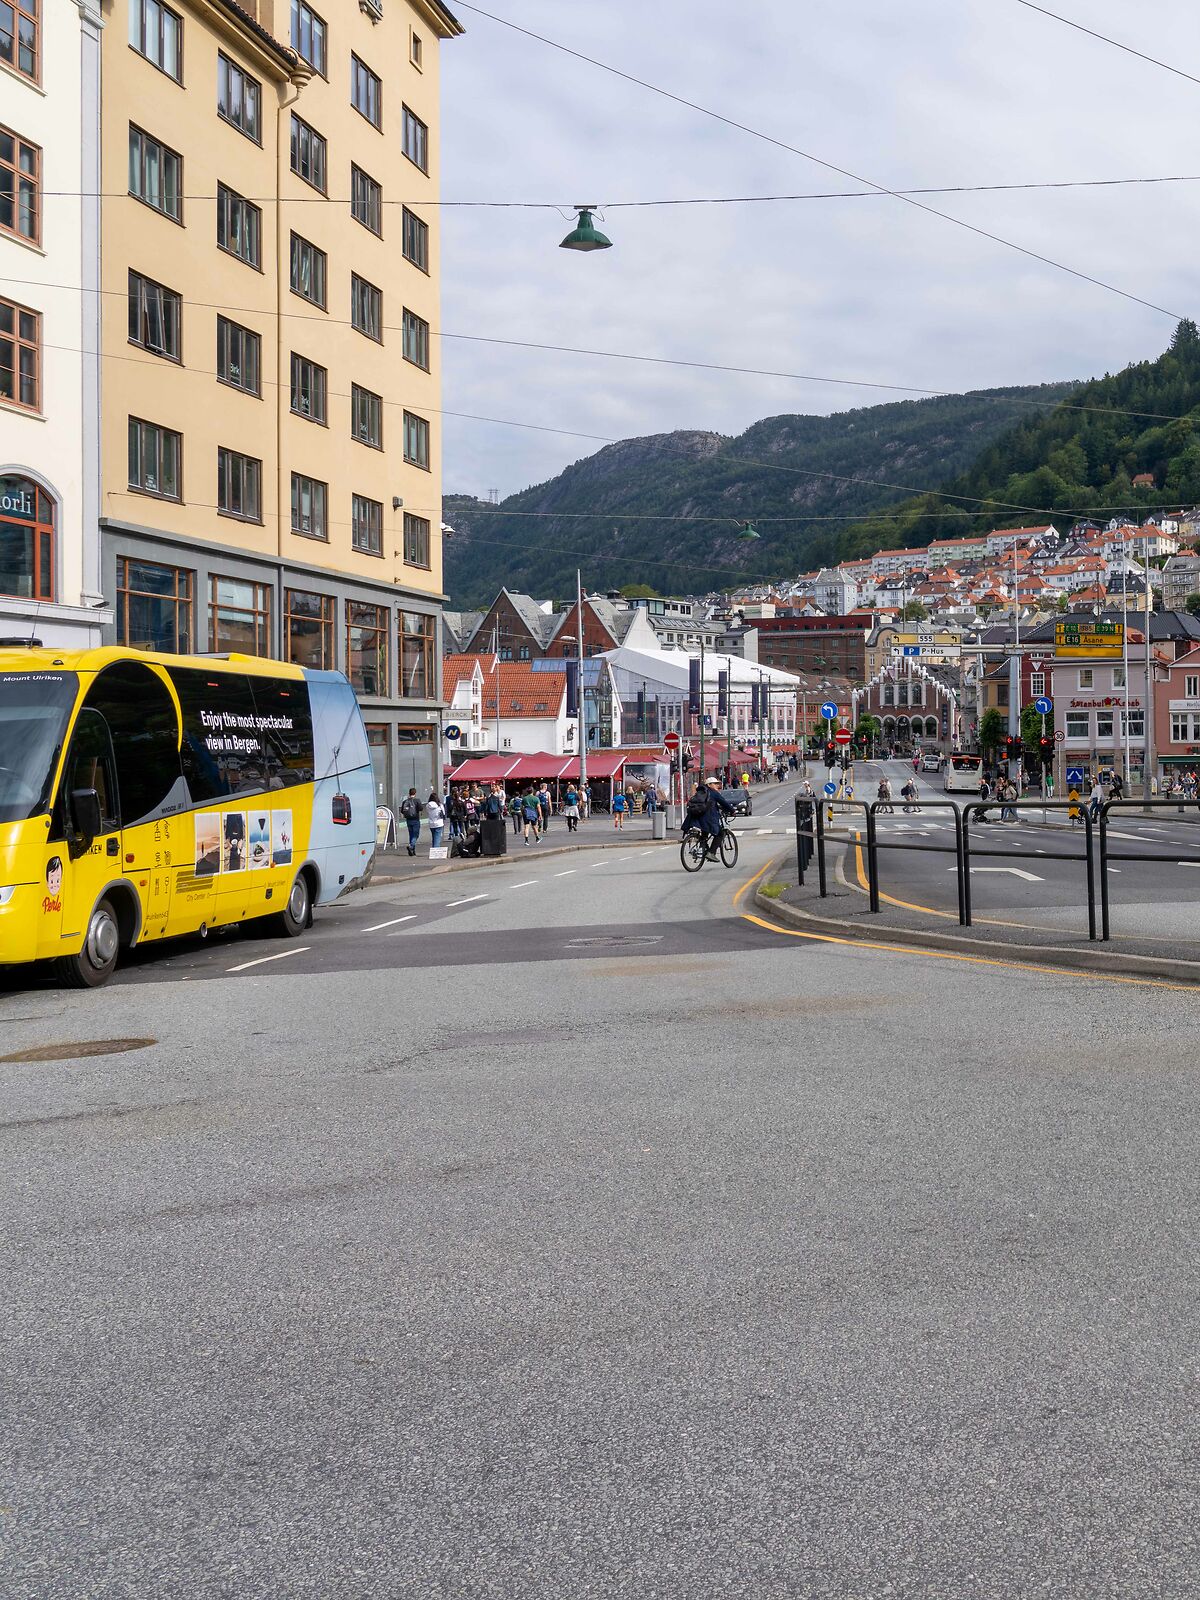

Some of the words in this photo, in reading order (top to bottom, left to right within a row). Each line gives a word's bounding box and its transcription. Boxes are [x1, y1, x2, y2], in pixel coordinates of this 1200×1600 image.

[0, 491, 32, 514] orli
[200, 710, 223, 731] Enjoy
[223, 711, 237, 727] the
[236, 713, 256, 728] most
[255, 714, 293, 731] spectacular
[205, 734, 224, 750] view
[223, 734, 233, 750] in
[232, 734, 261, 753] Bergen.
